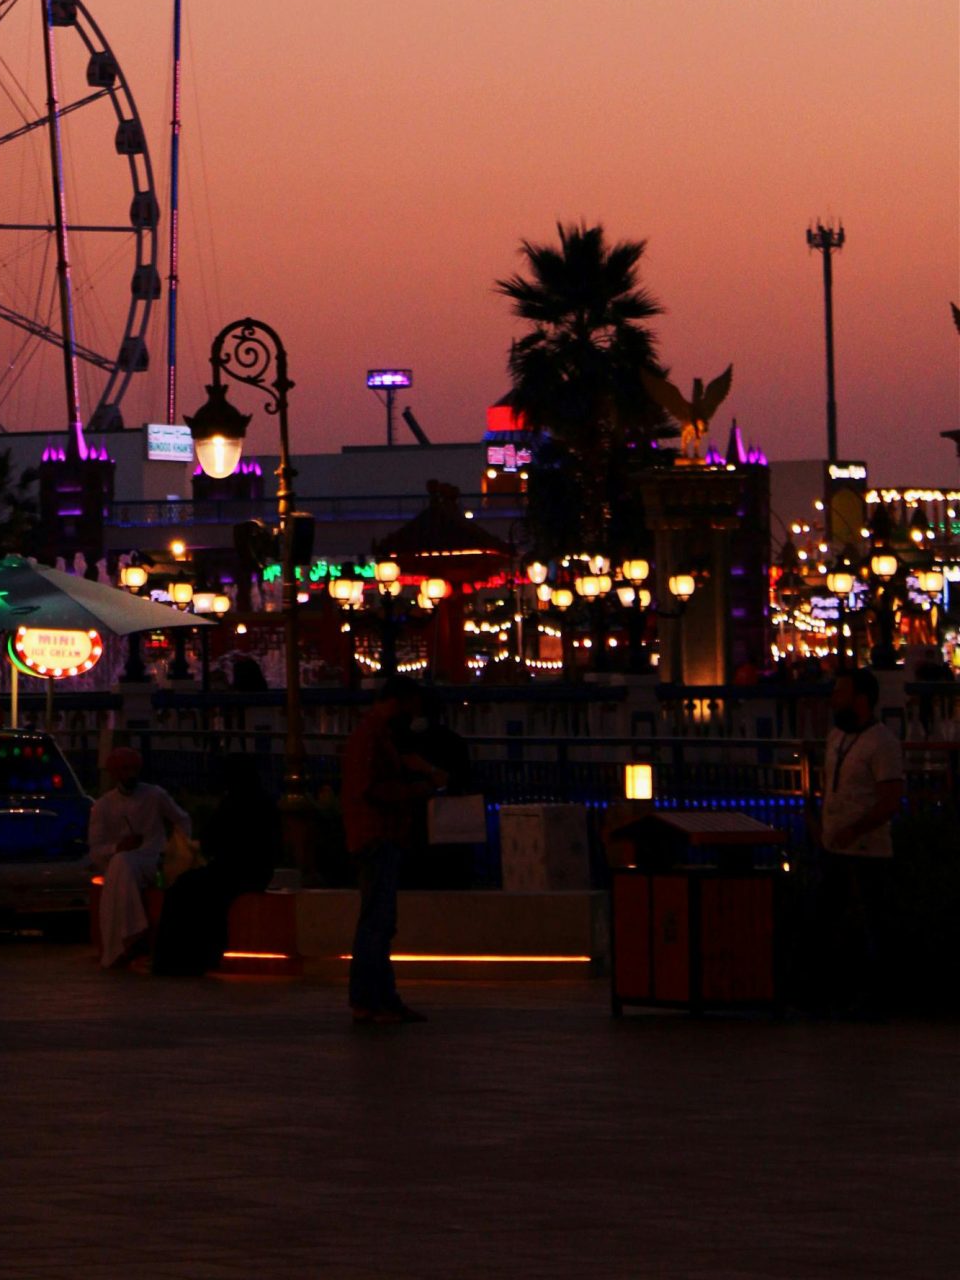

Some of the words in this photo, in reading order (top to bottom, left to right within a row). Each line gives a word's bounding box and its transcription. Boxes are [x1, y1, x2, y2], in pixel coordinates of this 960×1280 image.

[38, 634, 76, 646] MINI
[31, 648, 45, 656] ICE
[49, 649, 81, 658] CREAM
